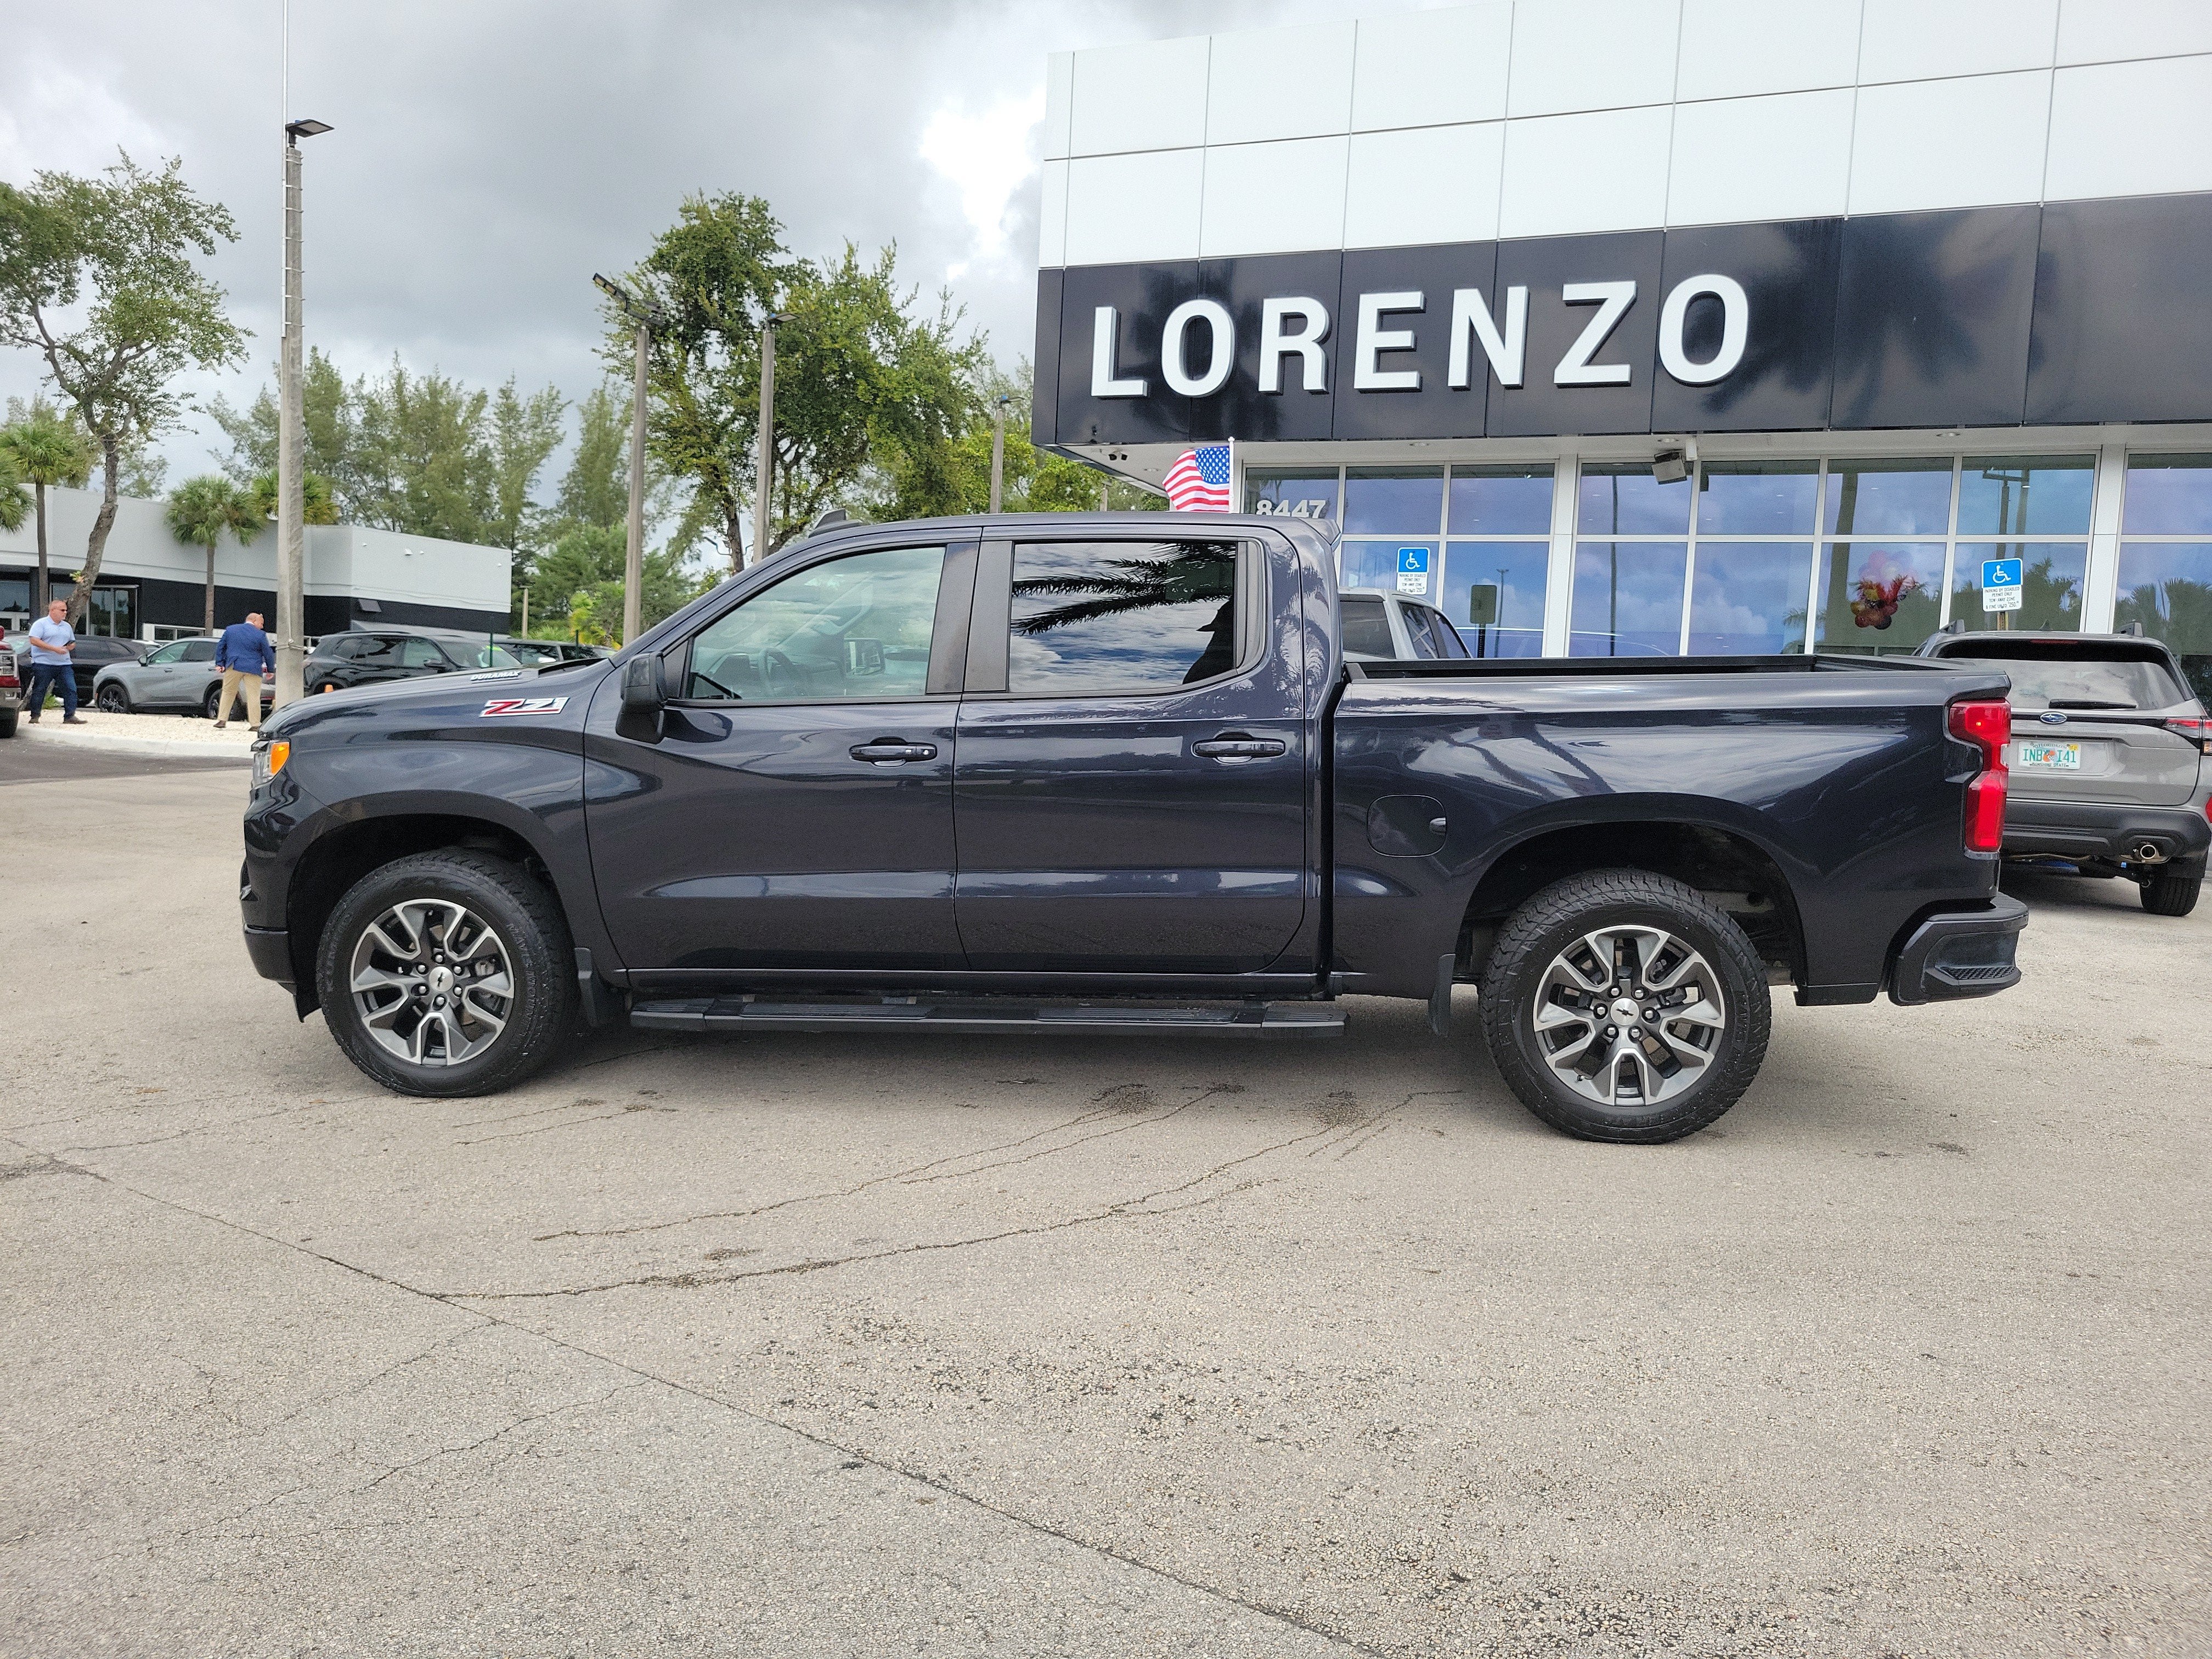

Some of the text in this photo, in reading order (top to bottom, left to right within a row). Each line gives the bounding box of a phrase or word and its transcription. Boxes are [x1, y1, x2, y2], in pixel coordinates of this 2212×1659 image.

[1091, 273, 1750, 398] LORENZO
[1256, 500, 1326, 519] 8447
[470, 670, 521, 681] DURAMAX
[479, 697, 571, 718] Z71
